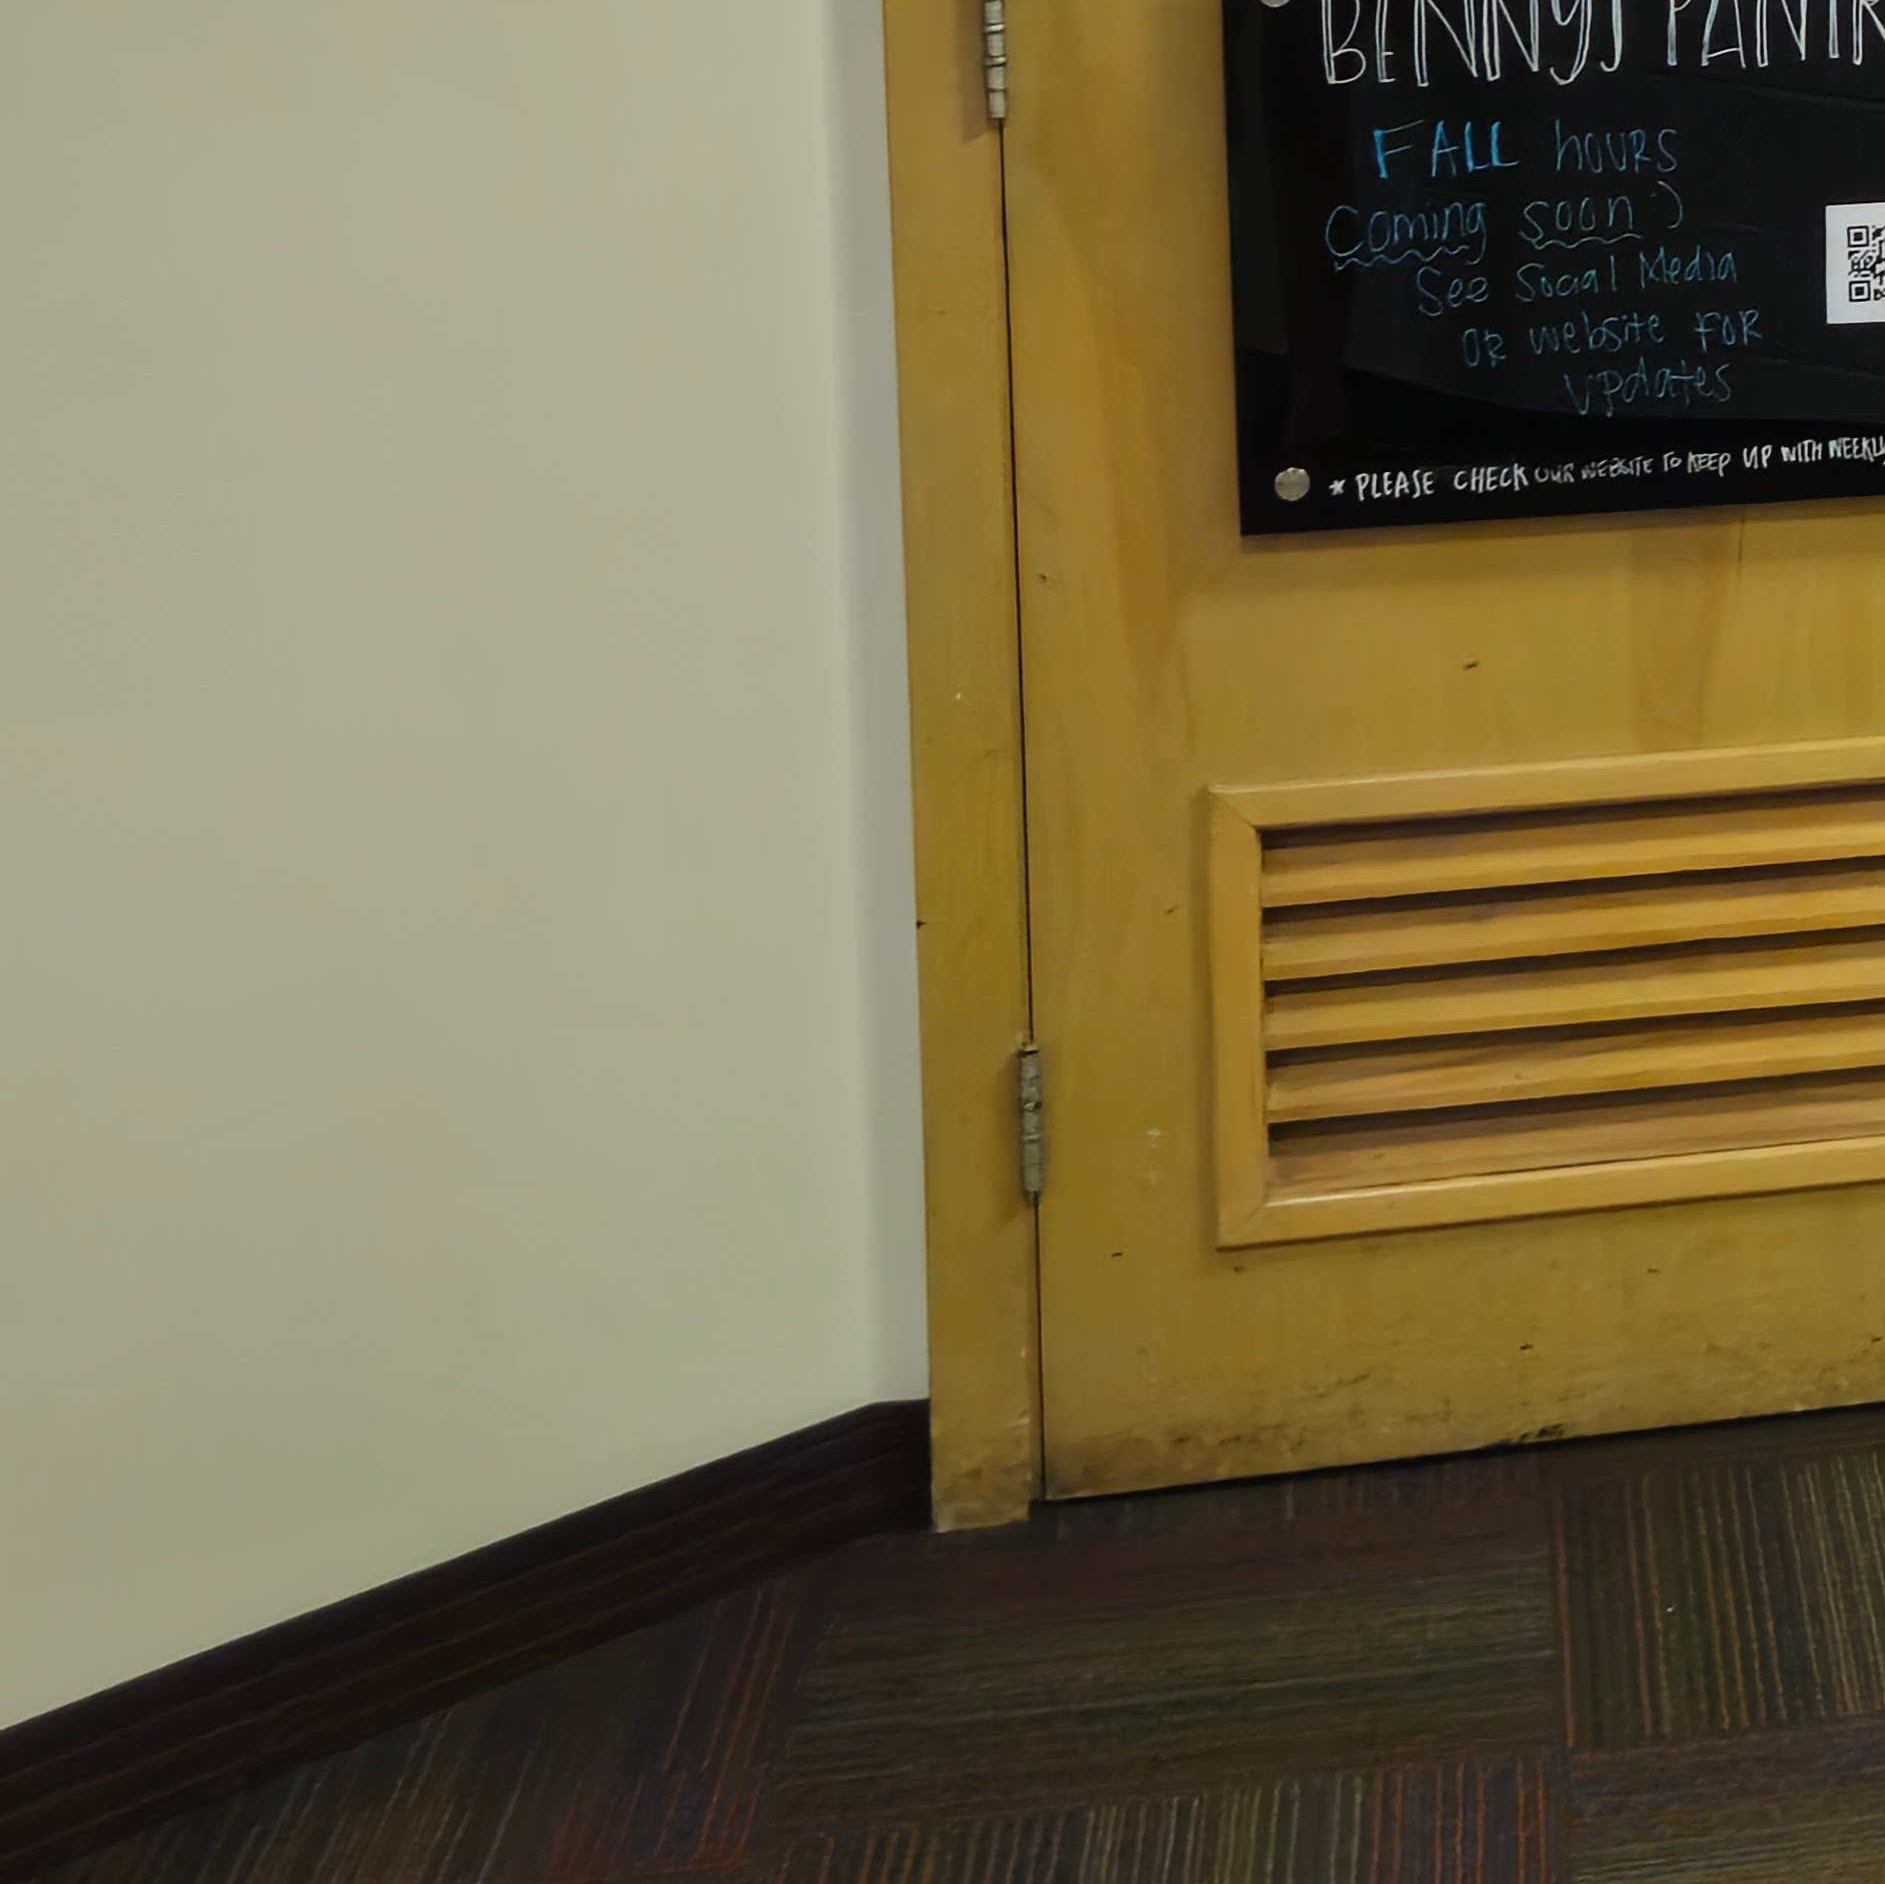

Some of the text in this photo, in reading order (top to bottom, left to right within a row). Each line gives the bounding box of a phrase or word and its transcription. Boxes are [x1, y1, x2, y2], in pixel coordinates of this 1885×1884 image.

[1372, 119, 1519, 180] FALL
[1324, 200, 1488, 265] Coming
[1416, 245, 1738, 317] See Social Media
[1453, 462, 1530, 493] CHECK
[1534, 462, 1576, 485] OUR
[1580, 456, 1655, 481] WEBSITE
[1686, 450, 1732, 478] KEEP
[1742, 444, 1773, 470] UP
[1780, 438, 1823, 464] WITH
